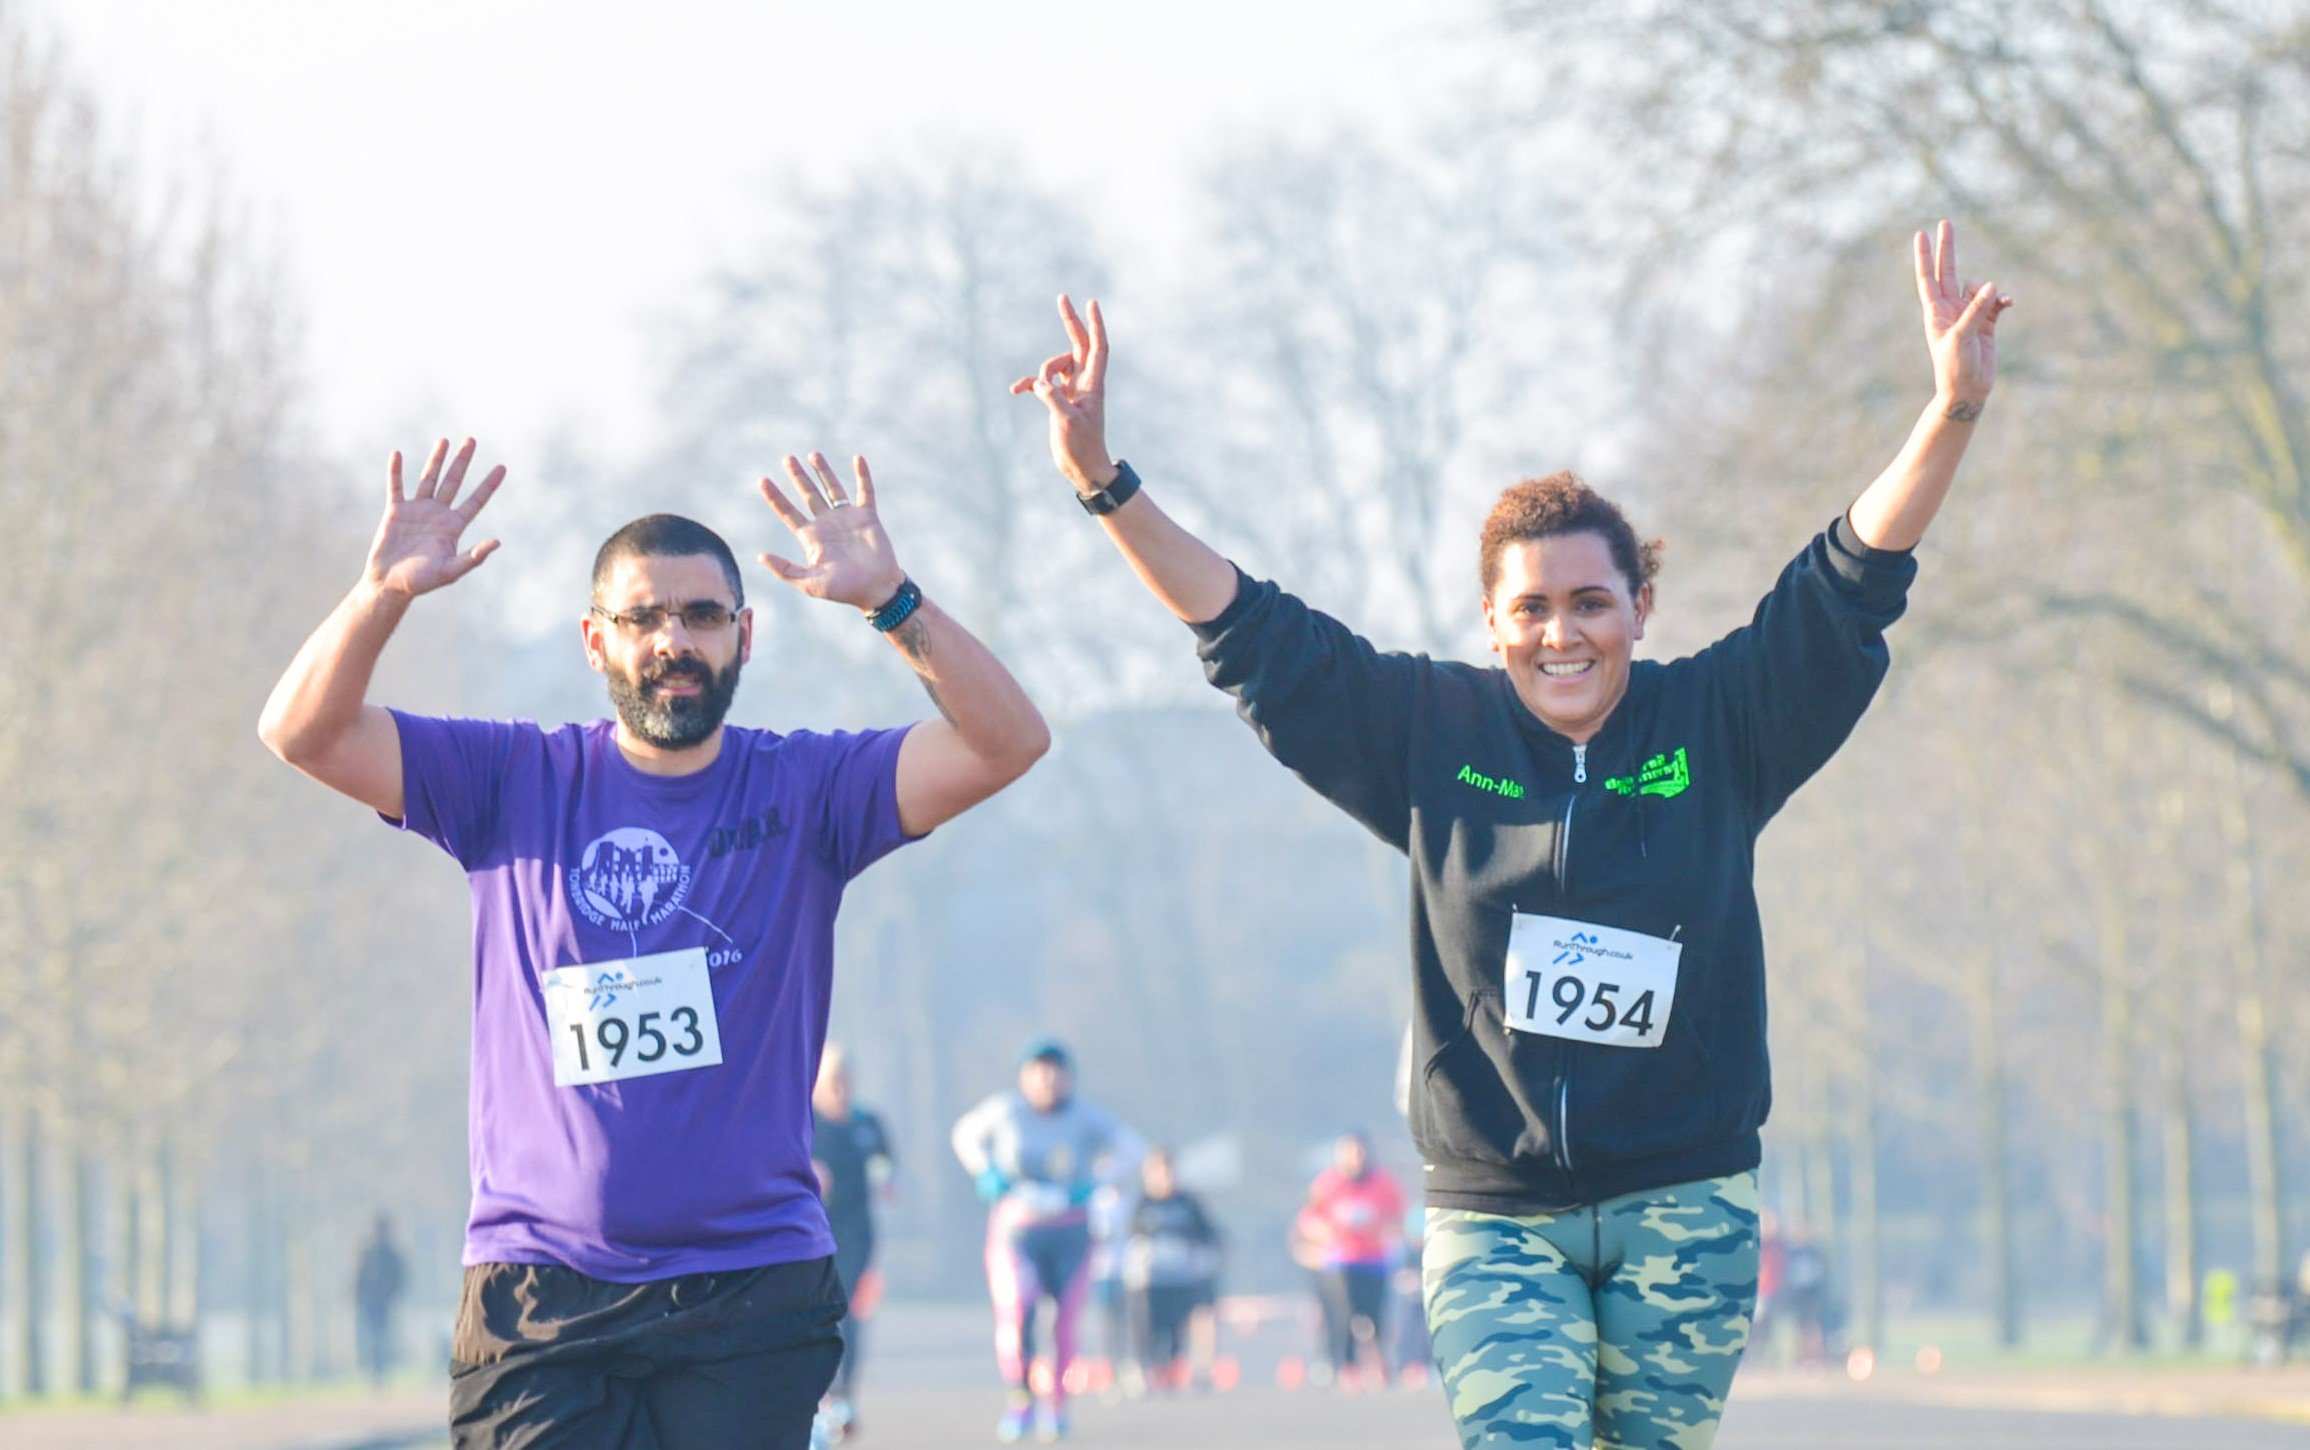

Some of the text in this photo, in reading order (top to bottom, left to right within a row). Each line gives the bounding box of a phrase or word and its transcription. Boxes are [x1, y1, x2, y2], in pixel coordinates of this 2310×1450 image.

[709, 949, 743, 967] 016
[1526, 970, 1655, 1037] 1954
[569, 1006, 704, 1071] 1953
